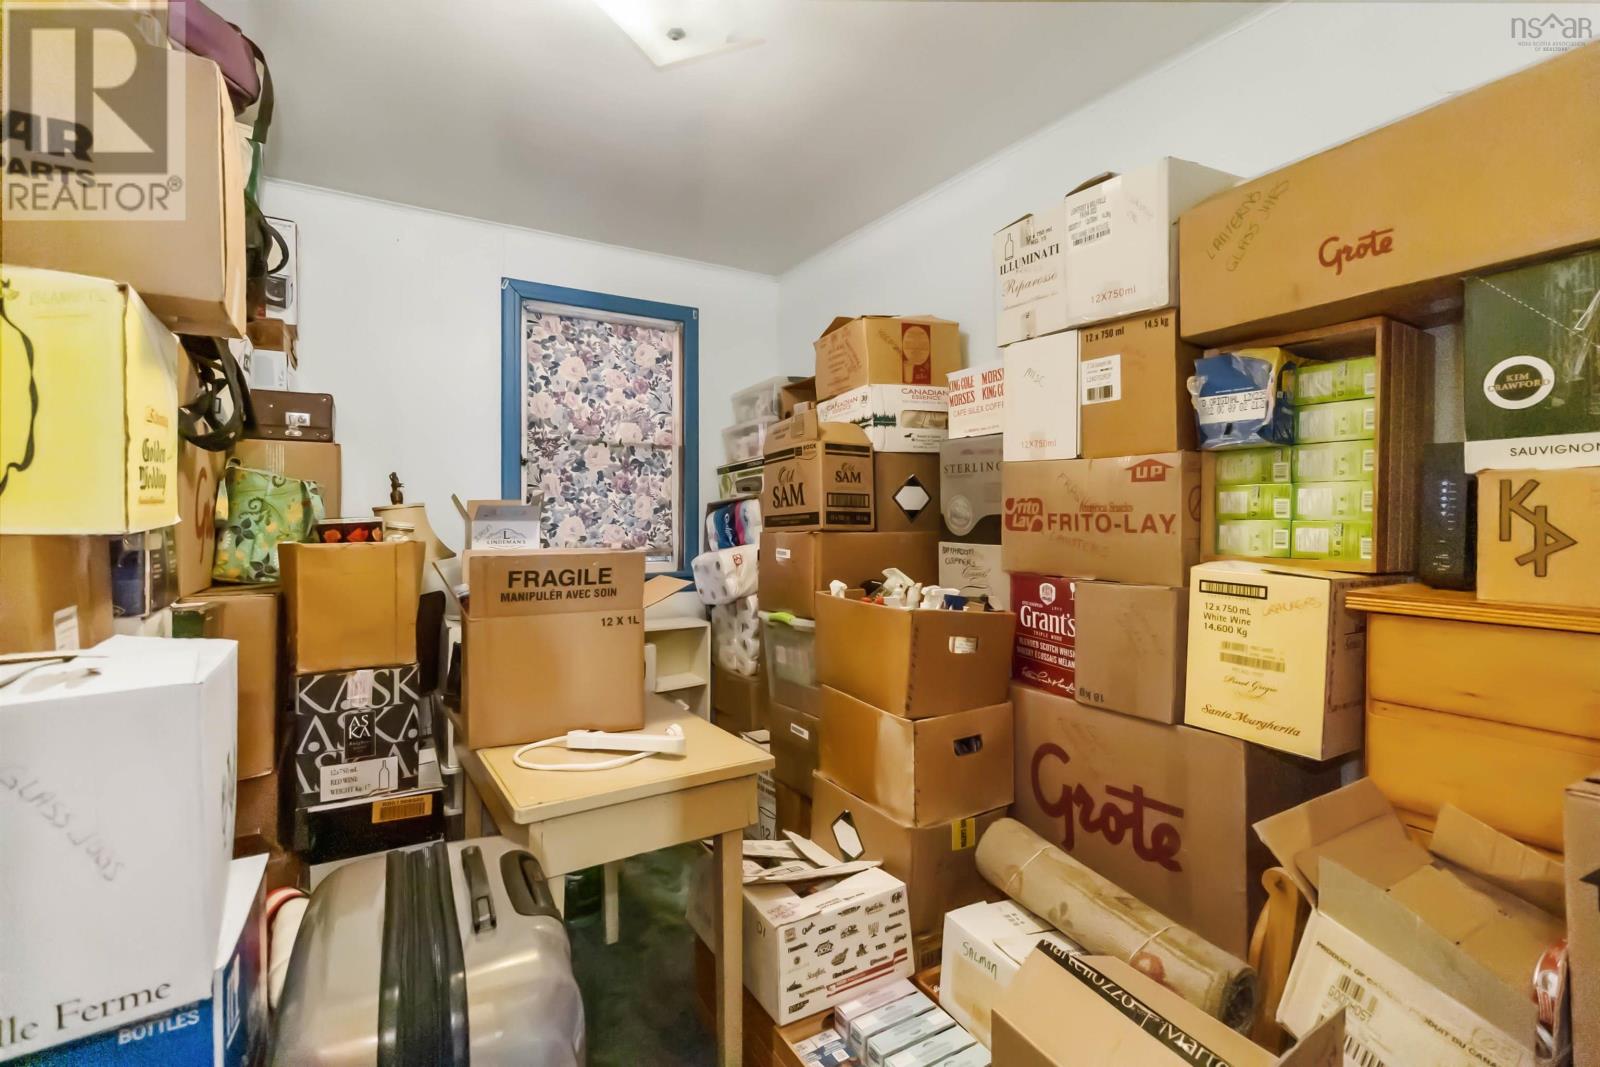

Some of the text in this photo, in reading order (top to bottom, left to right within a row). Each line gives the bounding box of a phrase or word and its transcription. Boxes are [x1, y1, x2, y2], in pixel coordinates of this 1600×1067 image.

[1000, 243, 1060, 276] ILLUMINATI
[1318, 228, 1394, 276] Grote
[1161, 316, 1169, 328] kg
[1085, 334, 1095, 343] 12
[1100, 328, 1115, 341] 750
[1115, 326, 1125, 337] ml
[1505, 373, 1530, 382] KIM
[901, 387, 950, 397] CANADIAN
[982, 385, 997, 400] KING
[1487, 379, 1551, 393] CRAWFORD
[949, 390, 976, 408] MORSES
[835, 470, 862, 484] SAM
[1135, 465, 1164, 479] UP
[772, 482, 806, 509] SAM
[1047, 513, 1177, 535] FRITO-LAY
[507, 567, 613, 589] FRAGILE
[566, 588, 589, 600] AVEC
[593, 586, 617, 599] SOIN
[1204, 602, 1214, 611] 12
[1222, 604, 1238, 614] 750
[601, 616, 612, 627] 12
[628, 616, 641, 625] 1L
[1020, 604, 1076, 638] Grant's
[1203, 612, 1252, 626] White Wine
[1236, 626, 1248, 638] Kg
[1039, 641, 1059, 655] SCOTCH
[1201, 703, 1302, 737] Santa Margherita
[1031, 743, 1184, 872] Grote
[961, 940, 998, 980] SALMON
[55, 983, 171, 1031] Ferme
